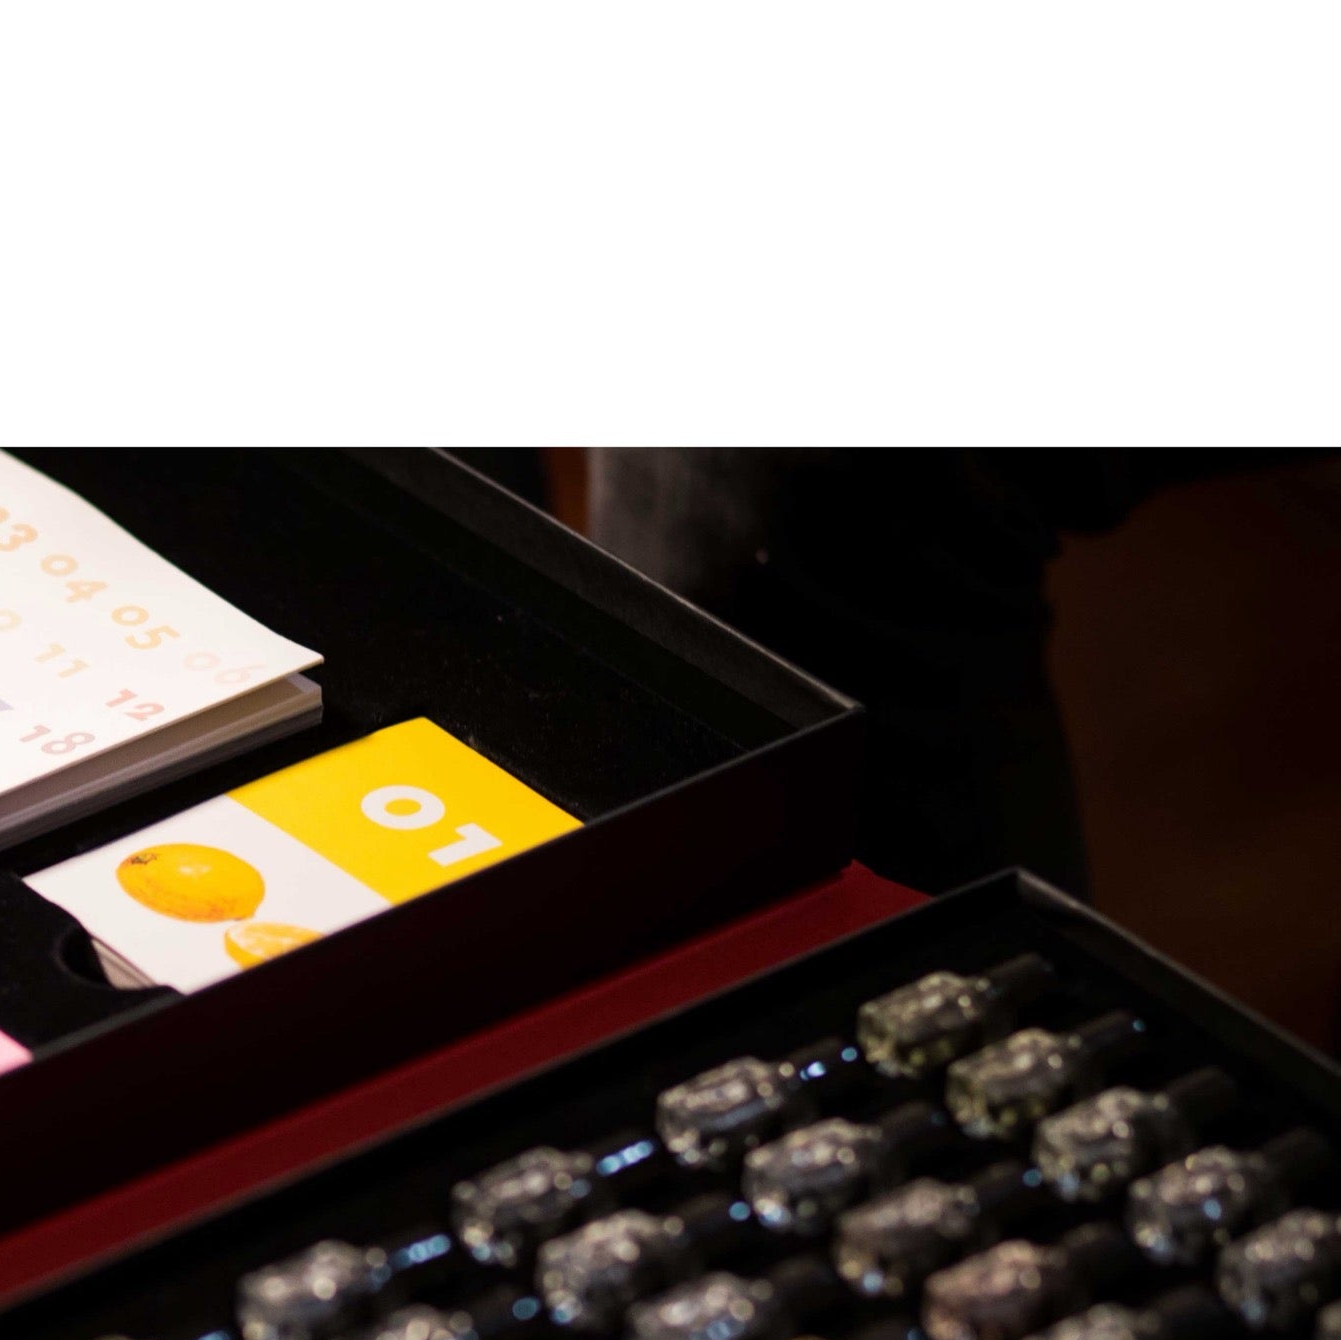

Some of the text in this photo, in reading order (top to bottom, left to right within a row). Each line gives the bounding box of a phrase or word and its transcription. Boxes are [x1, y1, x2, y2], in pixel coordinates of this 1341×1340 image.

[40, 553, 109, 604] 04
[111, 604, 181, 650] 05
[182, 651, 267, 685] 06
[34, 642, 90, 679] 11
[105, 688, 165, 721] 12
[18, 724, 96, 755] 18
[360, 785, 503, 868] 01
